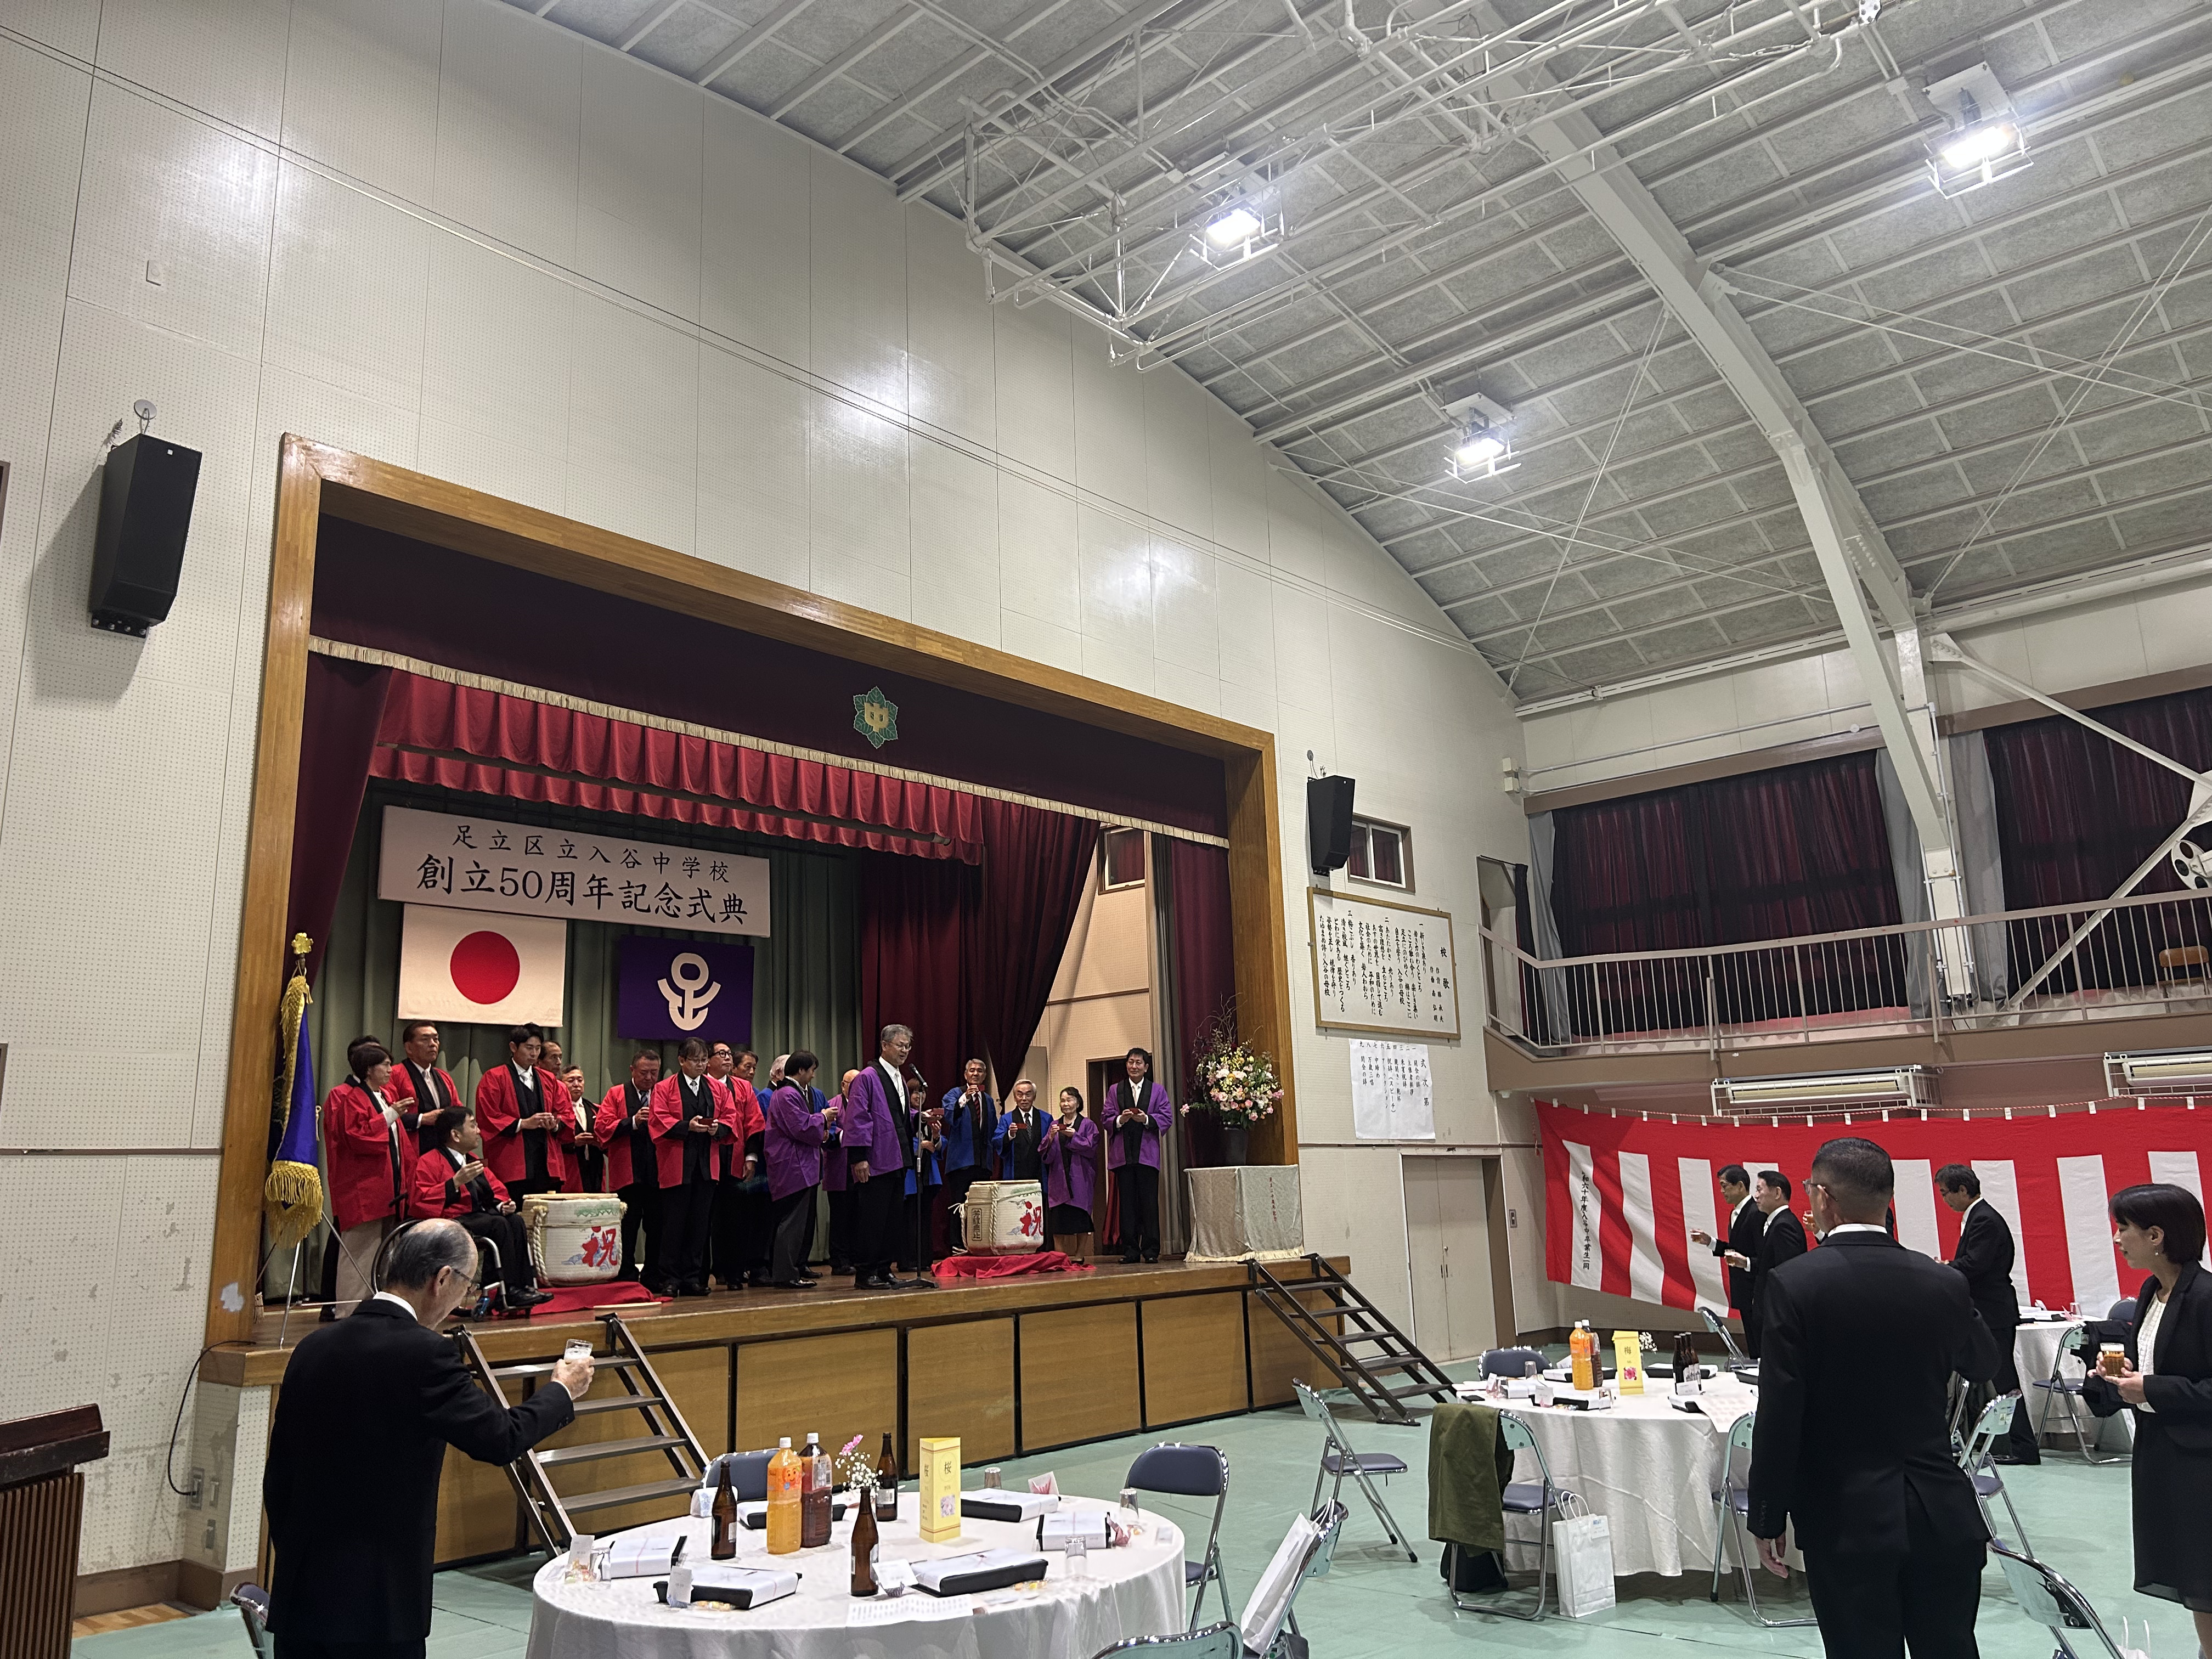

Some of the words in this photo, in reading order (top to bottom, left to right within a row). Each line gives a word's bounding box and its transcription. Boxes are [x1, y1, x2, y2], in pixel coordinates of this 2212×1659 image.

[452, 825, 730, 883] 足立区立入谷中学校
[416, 854, 748, 925] 創立50周年記念式典
[1020, 1201, 1044, 1237] 祝
[582, 1226, 618, 1267] 祝
[1624, 1346, 1632, 1355] 梅
[944, 1461, 952, 1474] 桜
